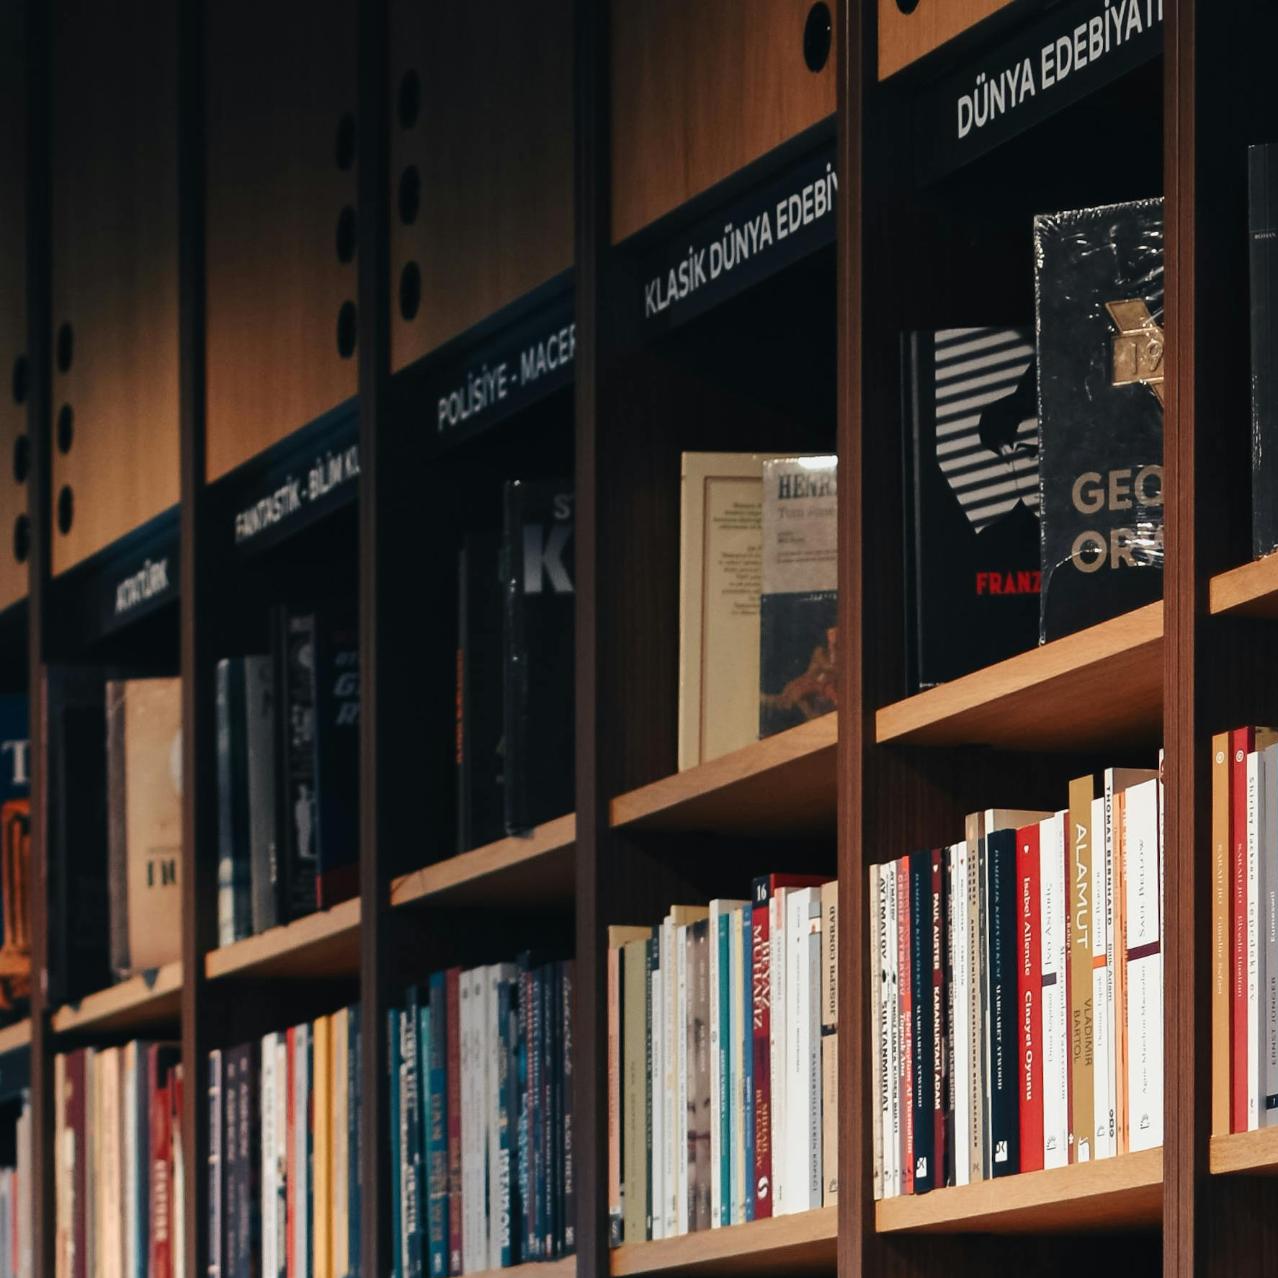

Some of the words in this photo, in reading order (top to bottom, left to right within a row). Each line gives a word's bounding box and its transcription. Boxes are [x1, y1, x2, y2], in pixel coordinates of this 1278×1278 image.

[958, 72, 1036, 139] DÜNYA
[645, 246, 707, 319] KLASİK
[709, 212, 774, 279] DÜNYA
[438, 363, 507, 432] POLİSİYE
[234, 475, 302, 545] FANTASTİK
[976, 571, 1041, 595] FRANZ
[1023, 877, 1031, 918] Isabel
[1076, 824, 1088, 950] ALAMUT
[753, 925, 762, 1029] MUHAFIZ
[1023, 922, 1031, 976] Allende
[1024, 991, 1032, 1047] Cinayet
[1073, 1009, 1082, 1064] BARTOL
[1083, 998, 1092, 1066] VLADIMIR
[1023, 1050, 1032, 1103] Oyunu
